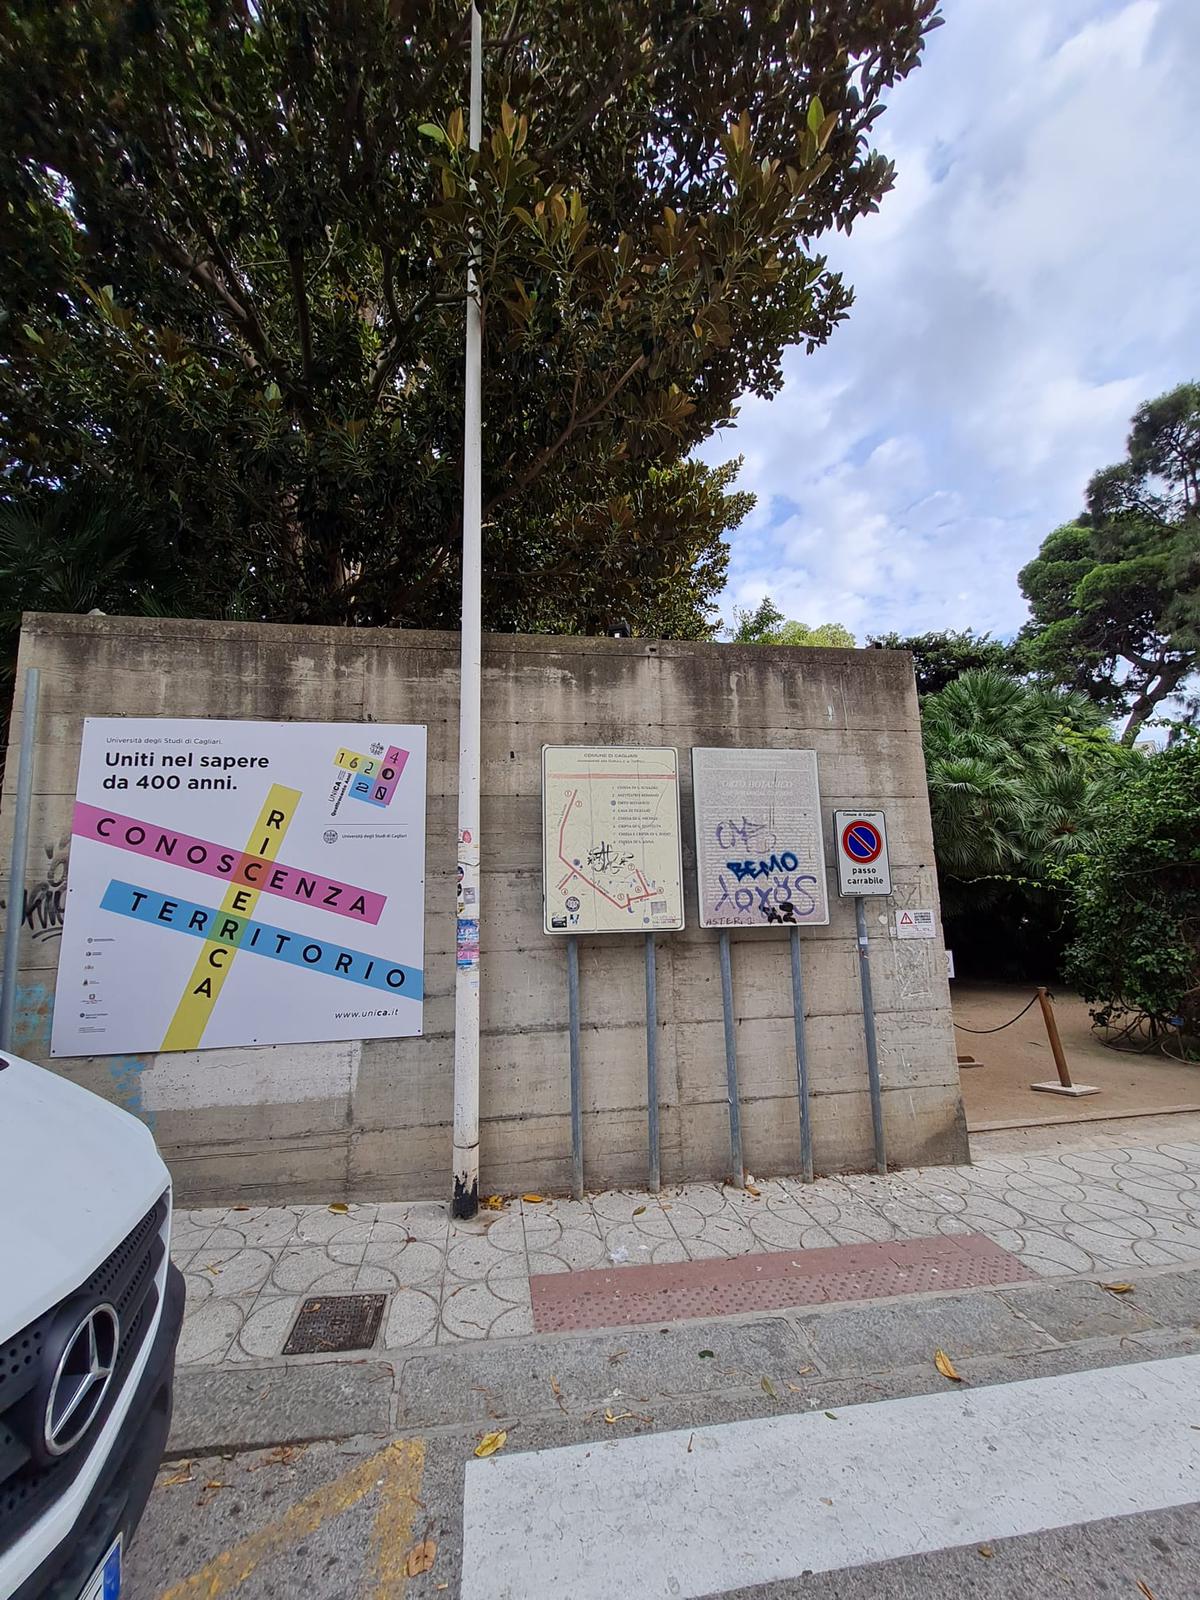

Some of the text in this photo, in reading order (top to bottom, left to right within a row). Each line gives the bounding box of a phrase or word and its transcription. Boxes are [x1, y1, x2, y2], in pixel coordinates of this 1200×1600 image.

[105, 752, 270, 770] Uniti nel sapere
[102, 774, 238, 790] da 400 anni.
[96, 817, 367, 916] CONOSCENZA
[726, 851, 799, 882] BEMO
[852, 868, 877, 876] passo
[847, 876, 884, 885] carrabile
[192, 809, 286, 999] RICERCA
[131, 891, 406, 989] TERRITORIO
[335, 1008, 399, 1019] www.unica.it
